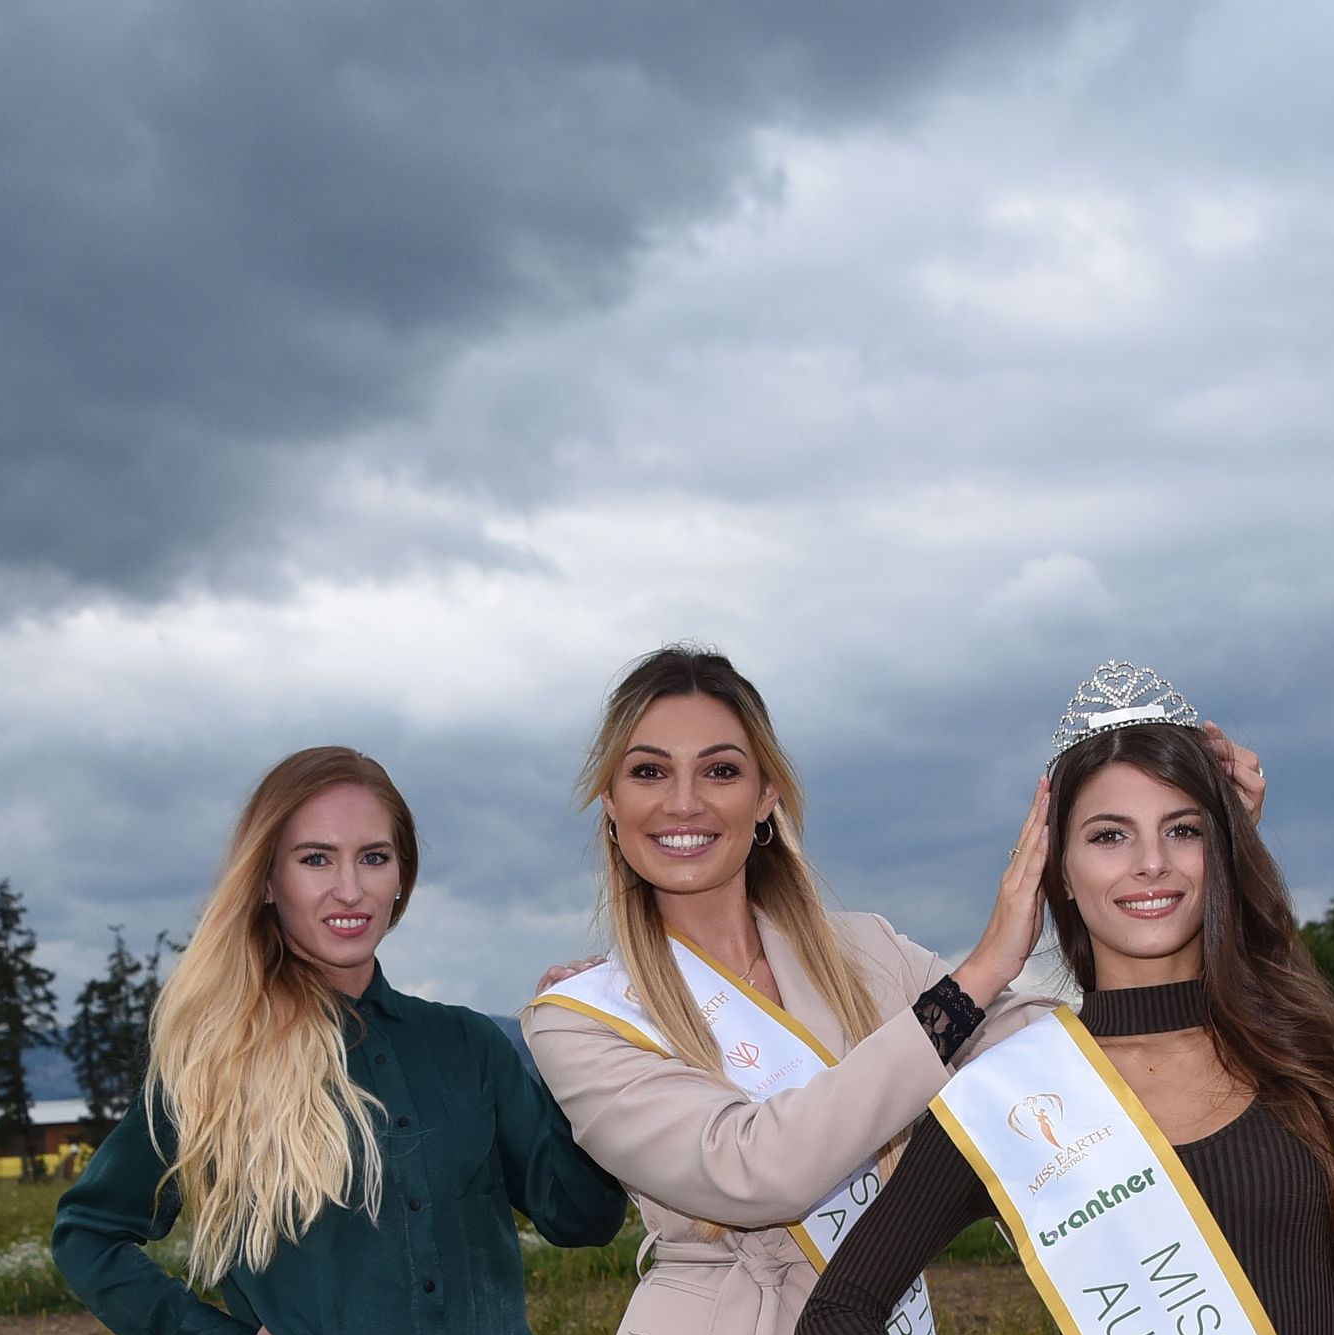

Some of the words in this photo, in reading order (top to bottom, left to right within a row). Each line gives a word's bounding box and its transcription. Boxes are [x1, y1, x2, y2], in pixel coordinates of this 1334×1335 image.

[1028, 1162, 1056, 1196] MISS
[1055, 1125, 1114, 1166] EARTH
[1055, 1152, 1088, 1181] AUSTRIA
[1039, 1167, 1156, 1248] brantner
